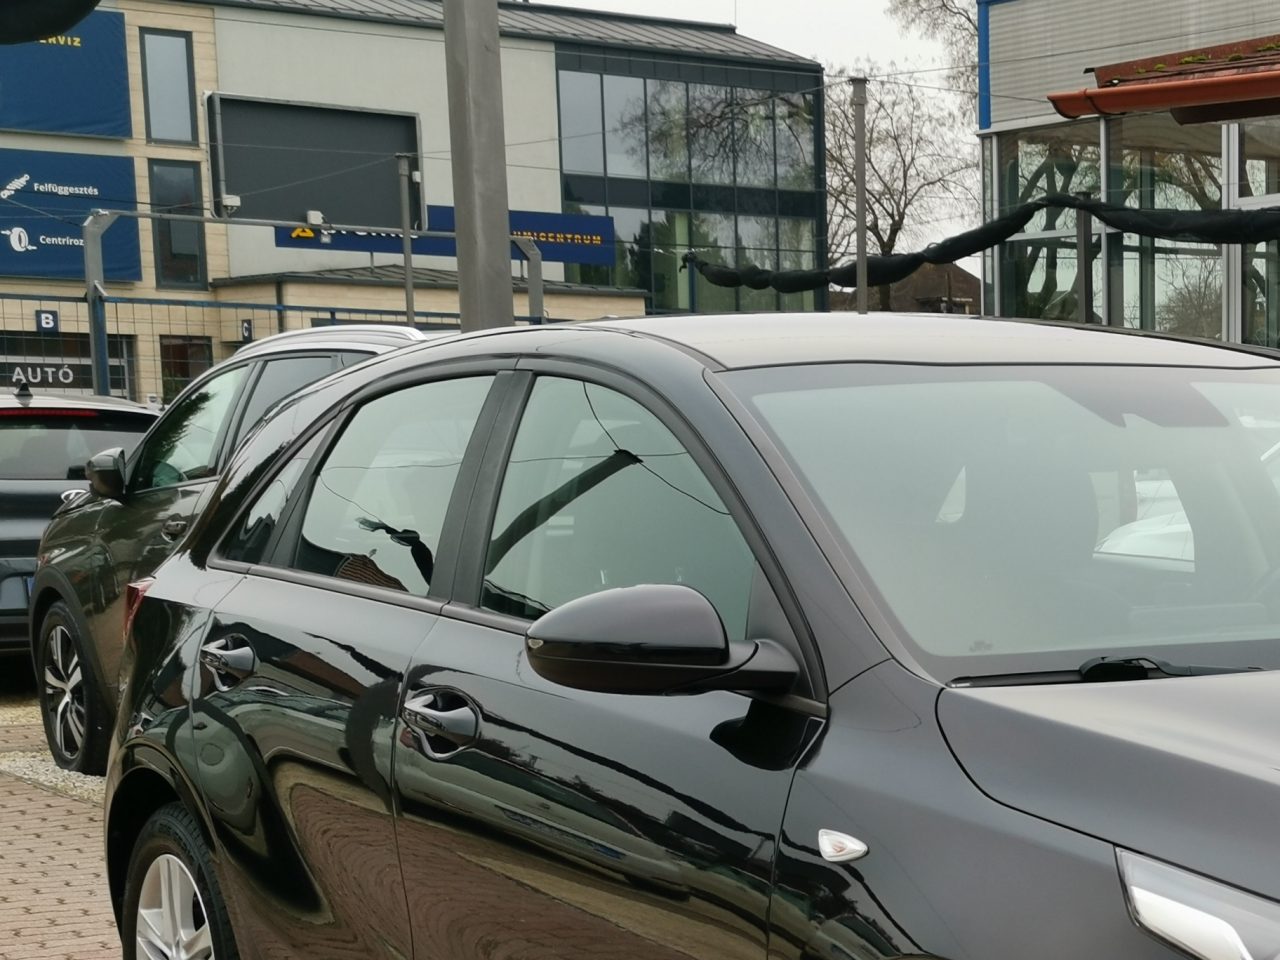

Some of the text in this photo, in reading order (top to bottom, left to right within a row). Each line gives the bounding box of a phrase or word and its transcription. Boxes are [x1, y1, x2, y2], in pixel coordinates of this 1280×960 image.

[34, 183, 98, 195] Felfüggesztés
[41, 313, 54, 329] B
[243, 324, 250, 337] C
[12, 365, 74, 384] AUTÓ
